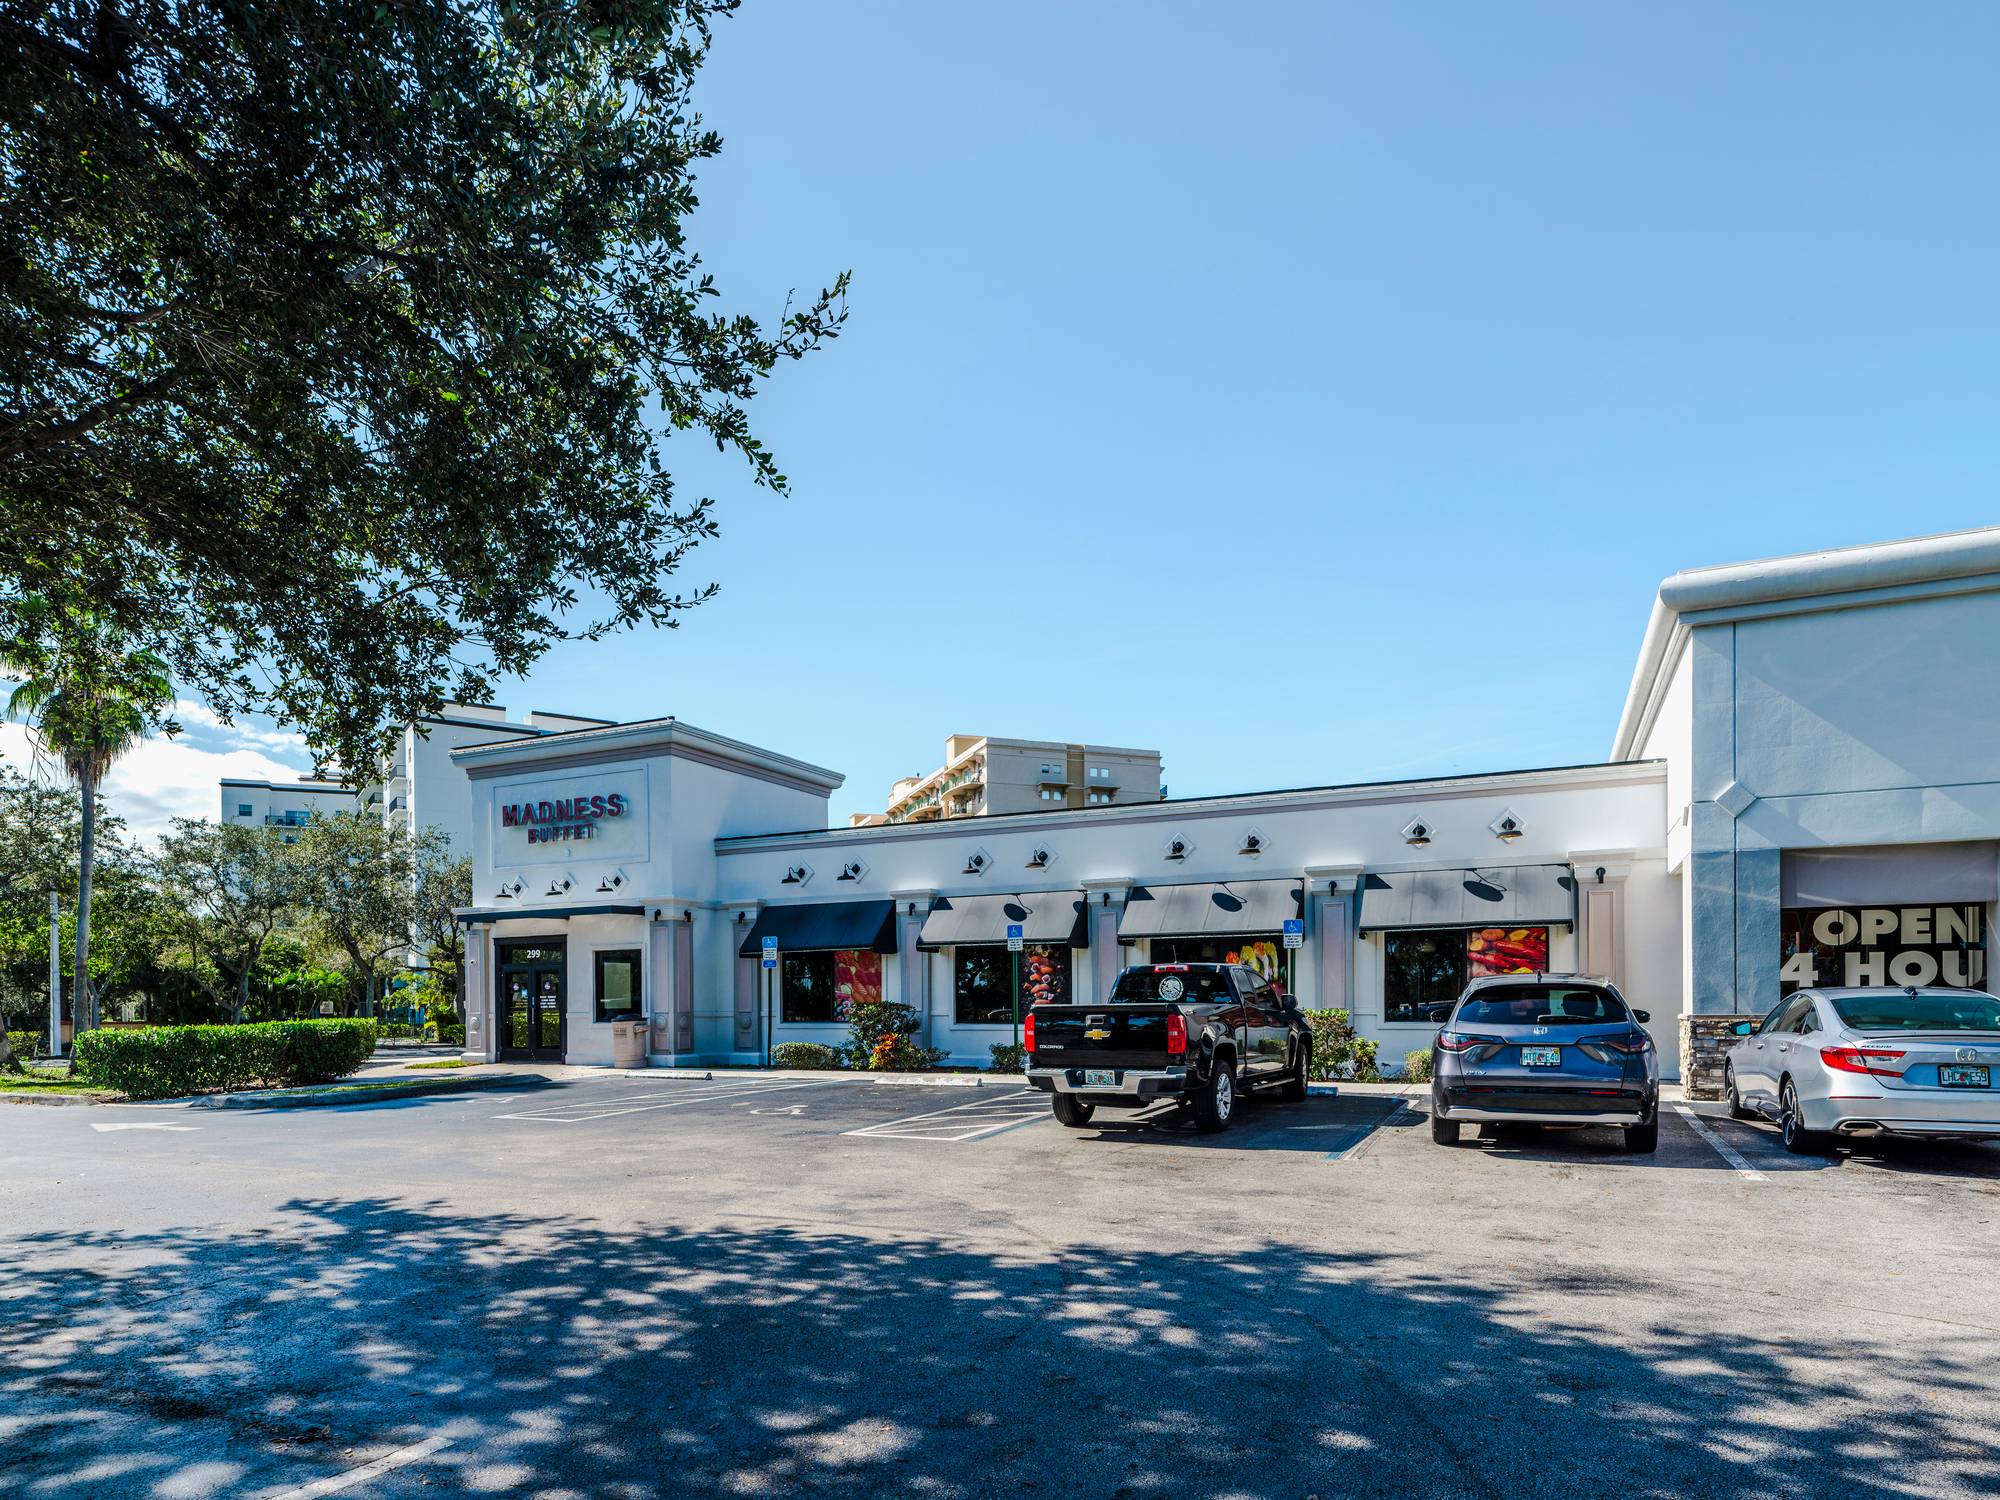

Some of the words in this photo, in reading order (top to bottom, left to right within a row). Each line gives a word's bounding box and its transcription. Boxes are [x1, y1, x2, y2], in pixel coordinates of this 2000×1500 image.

[502, 793, 624, 827] MADNESS
[527, 823, 594, 844] BUFFET
[1812, 906, 1980, 946] OPEN
[526, 949, 541, 959] 299
[1844, 950, 1984, 988] HOU
